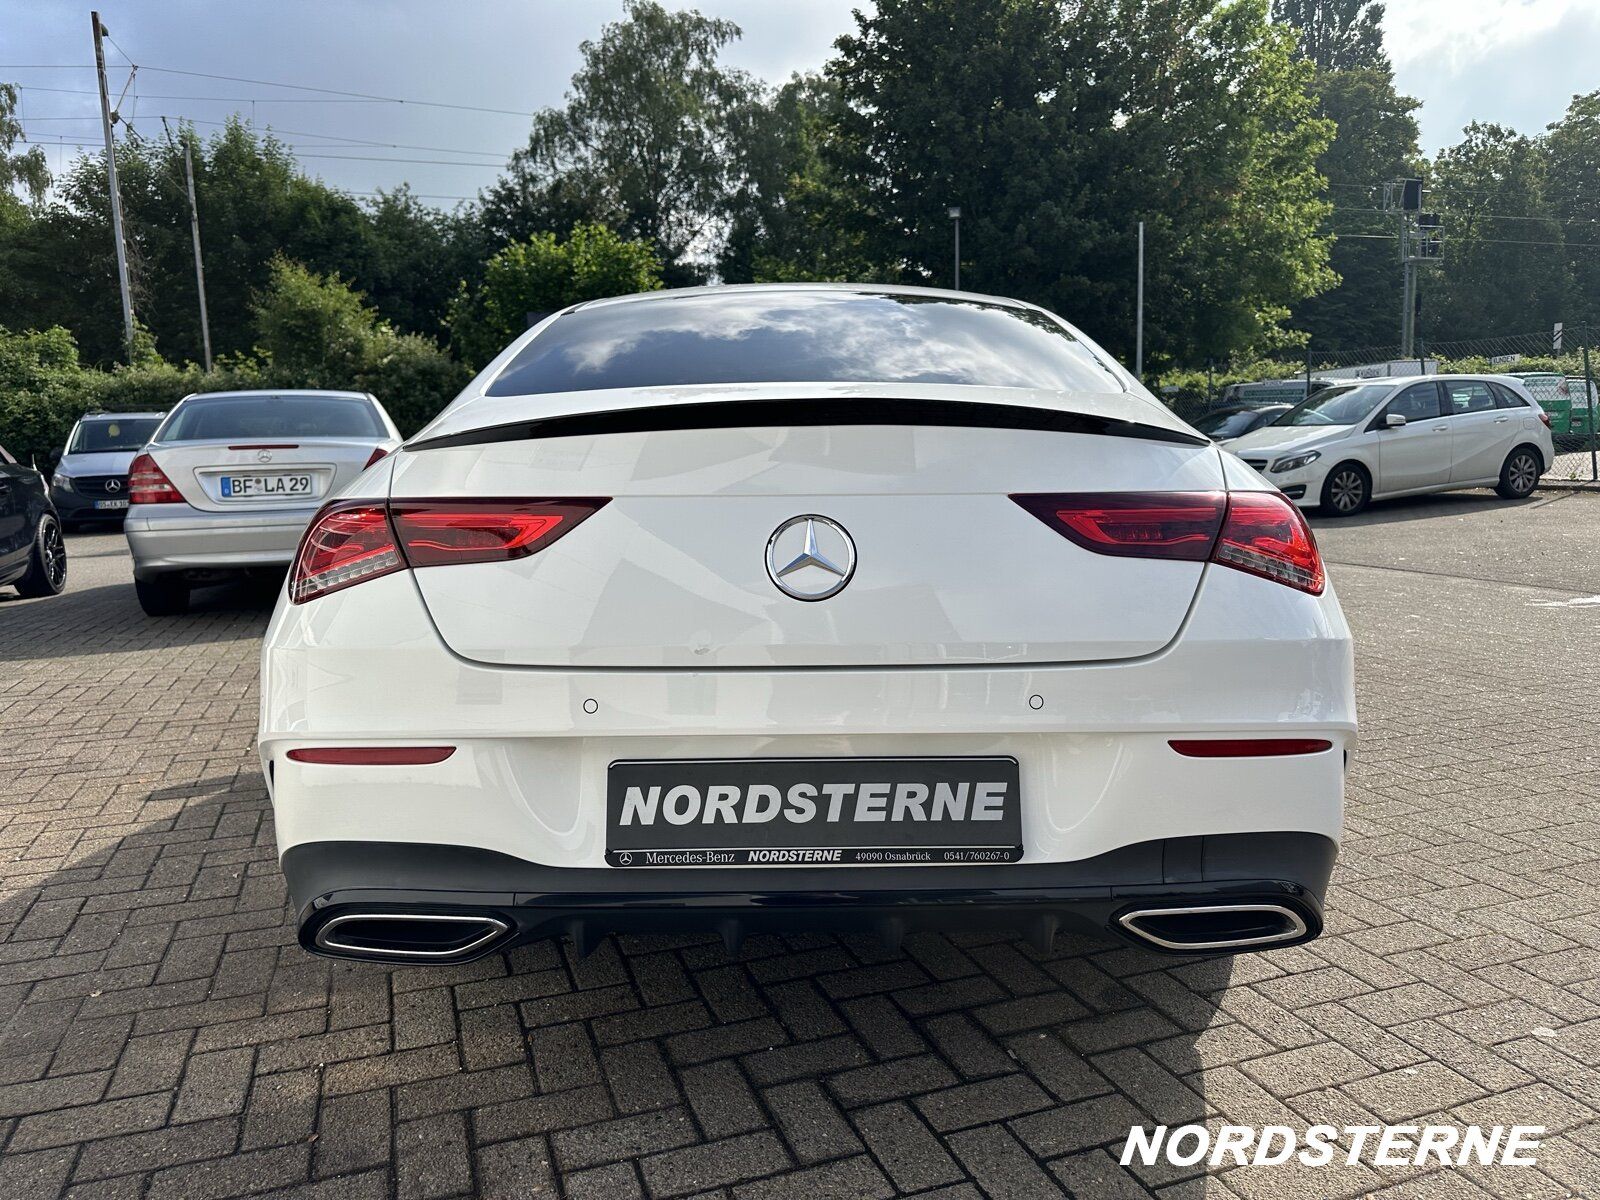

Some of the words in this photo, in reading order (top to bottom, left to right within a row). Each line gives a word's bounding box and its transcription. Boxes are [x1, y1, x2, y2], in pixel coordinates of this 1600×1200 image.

[231, 479, 254, 494] BF
[264, 477, 286, 492] LA
[289, 477, 309, 491] 29
[619, 782, 1008, 826] NORDSTERNE
[645, 852, 735, 864] Mercedes-Benz
[748, 850, 842, 862] NORDSTERNE
[855, 851, 883, 861] 49090
[884, 850, 931, 861] Osnabrück
[943, 850, 1010, 861] 0541/760267-0
